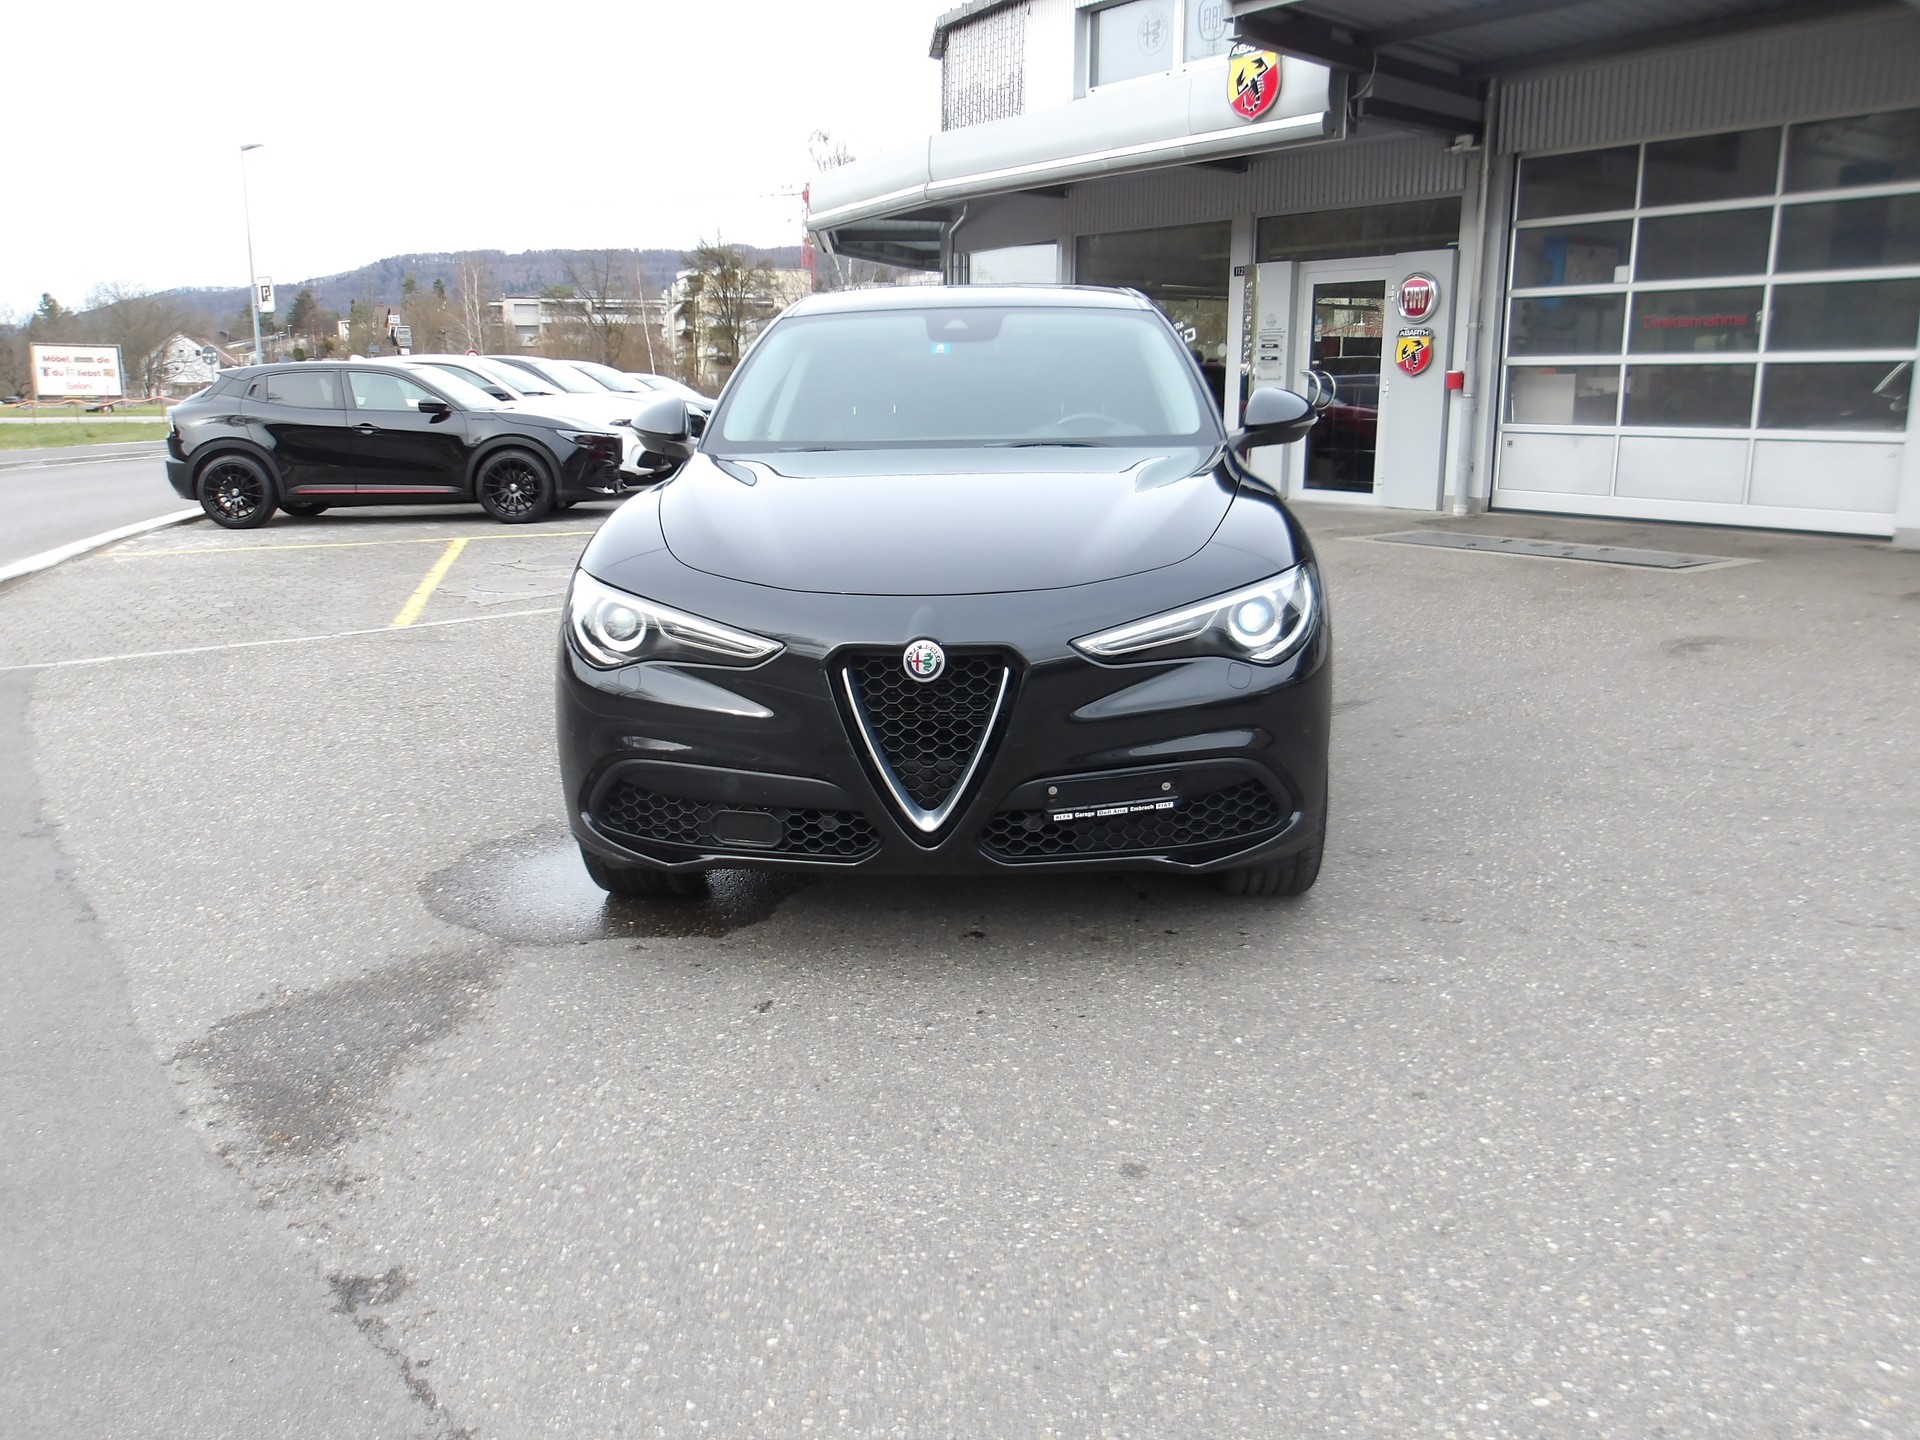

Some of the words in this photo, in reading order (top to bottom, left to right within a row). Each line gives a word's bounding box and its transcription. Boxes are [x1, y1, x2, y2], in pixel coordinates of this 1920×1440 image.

[1203, 5, 1223, 32] FIAT
[1231, 43, 1257, 56] ABA
[1235, 267, 1245, 275] 112
[1404, 286, 1428, 309] FIAT
[1644, 314, 1746, 330] Direktannahme
[77, 369, 101, 377] liebst
[1130, 804, 1154, 812] Embrach
